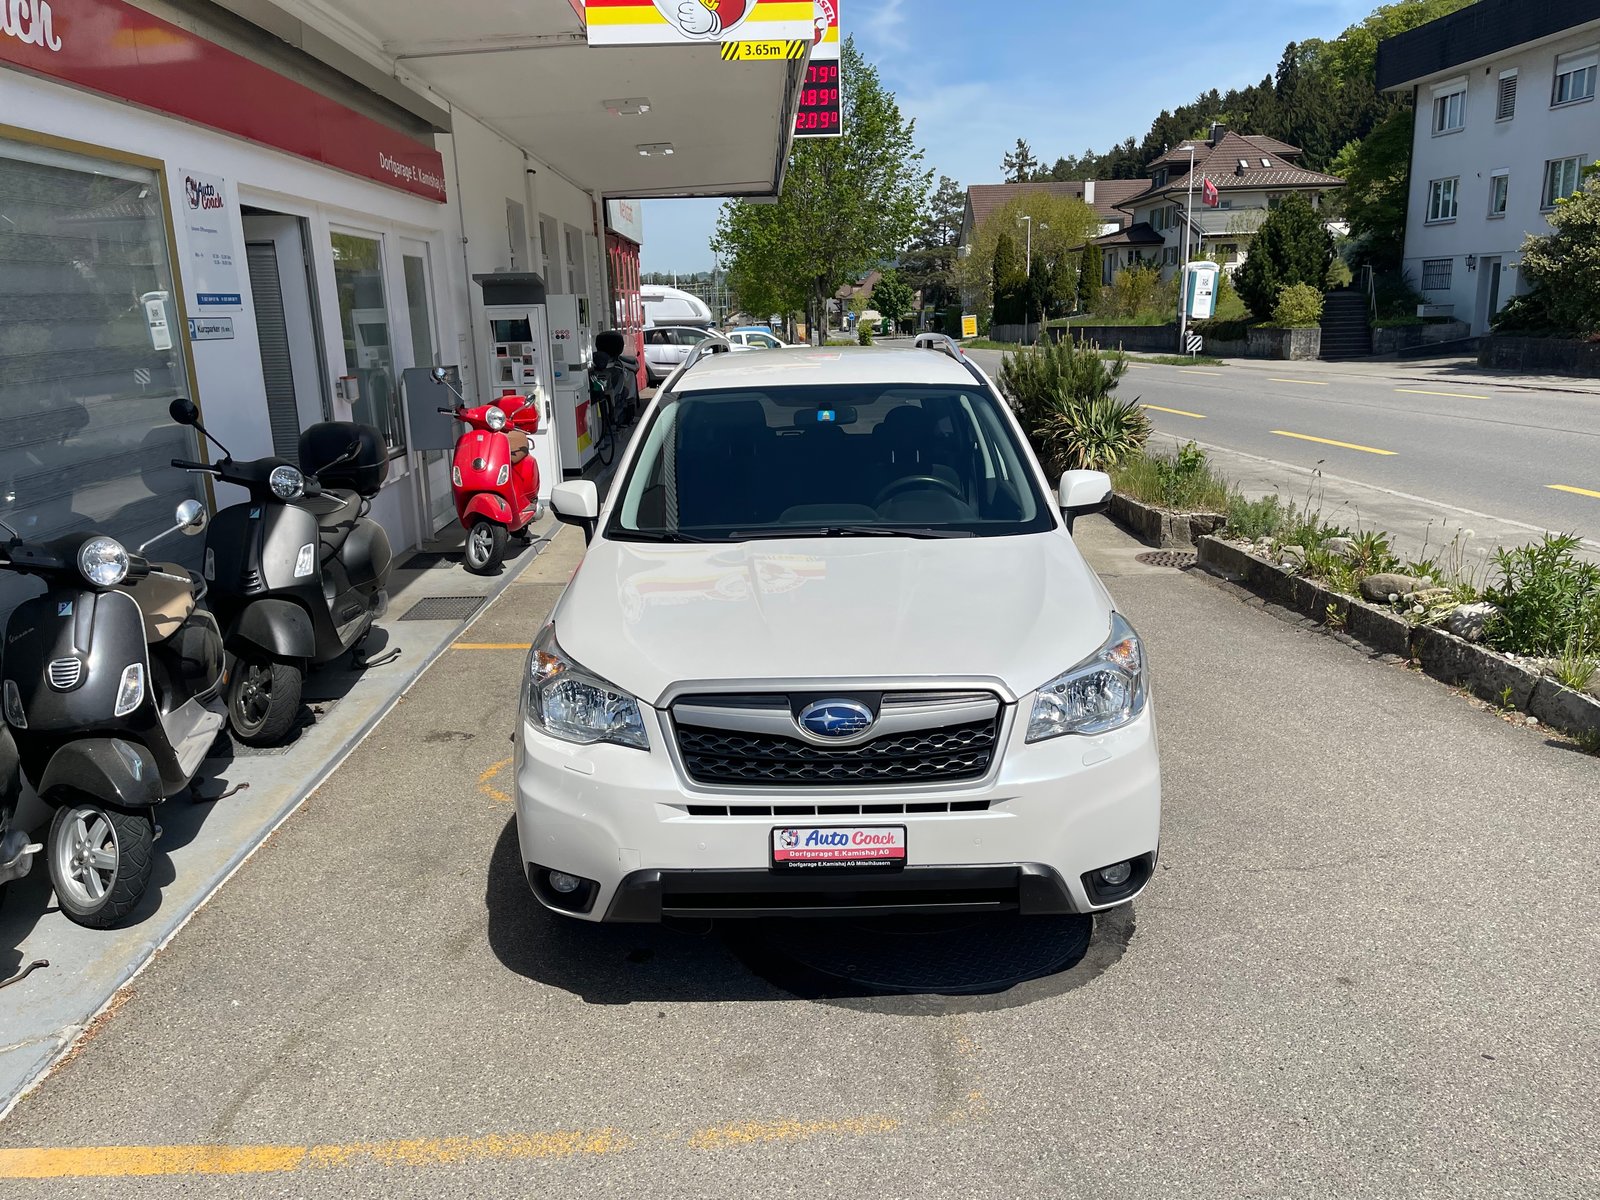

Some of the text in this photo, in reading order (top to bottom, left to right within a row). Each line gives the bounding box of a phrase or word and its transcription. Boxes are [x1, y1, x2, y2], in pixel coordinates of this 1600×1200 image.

[744, 44, 781, 56] 3.65m
[804, 66, 837, 83] .790
[379, 152, 412, 182] Dorfgarage
[197, 181, 214, 196] Auto
[201, 192, 224, 210] Coach
[805, 830, 895, 846] Auto Coach
